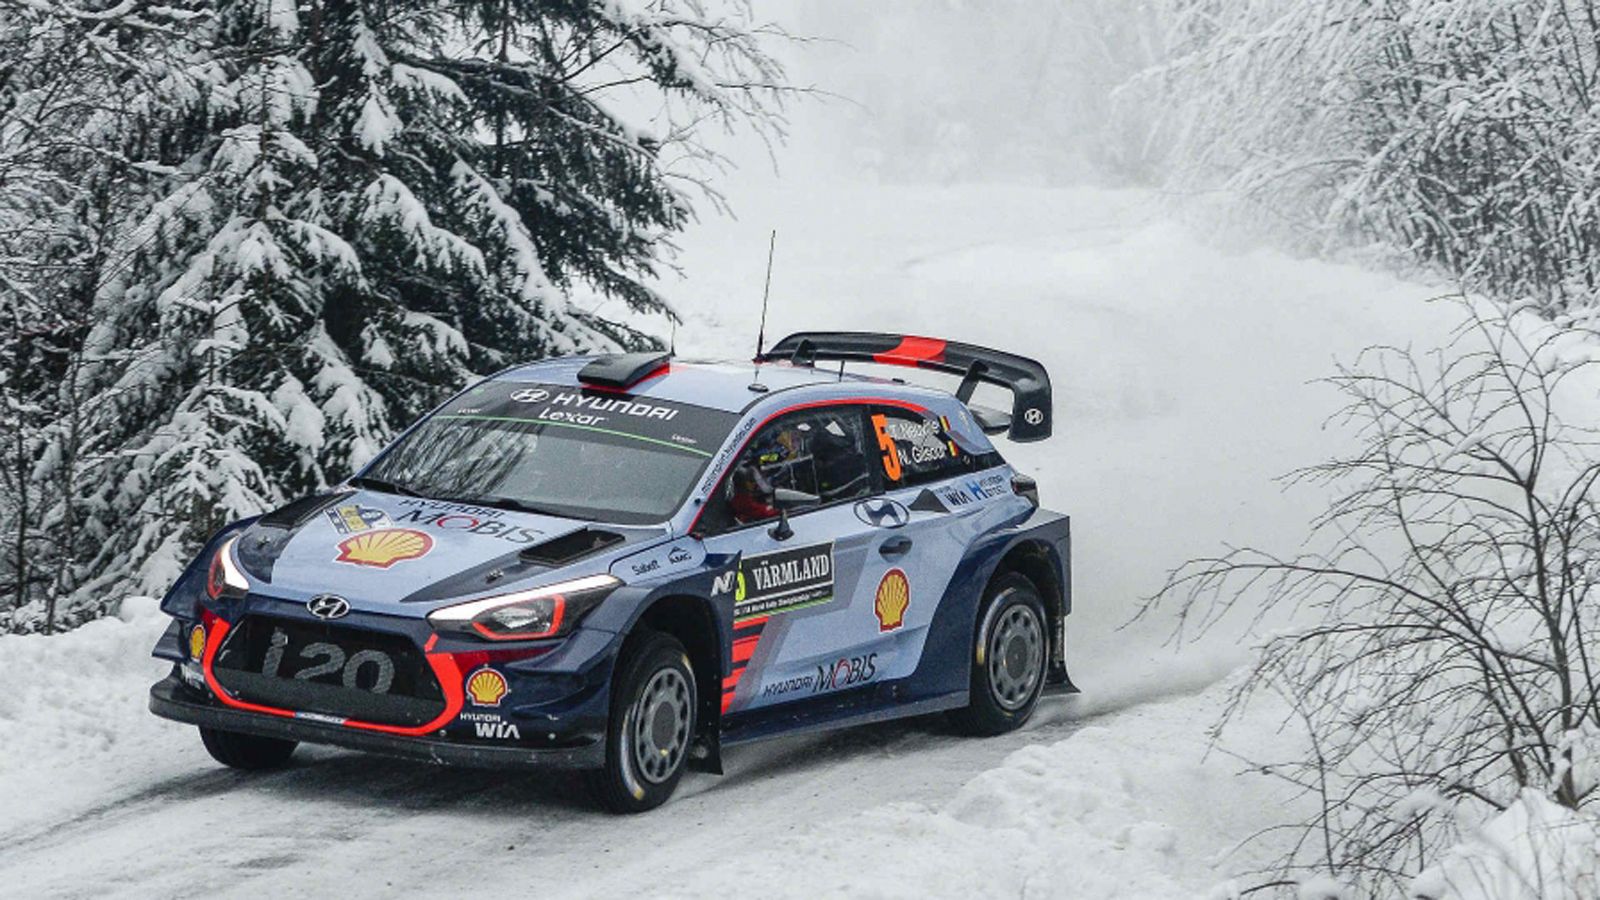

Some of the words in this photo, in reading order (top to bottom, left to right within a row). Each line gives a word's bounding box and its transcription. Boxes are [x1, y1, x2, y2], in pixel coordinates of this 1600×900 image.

[538, 407, 606, 427] Lexar
[552, 391, 679, 421] HYUNDAI
[871, 413, 902, 481] 5
[397, 509, 545, 544] MOBIS
[398, 499, 508, 519] HYUNDAI
[752, 553, 830, 591] VÄRMLAND
[763, 675, 814, 697] HYUNDAI
[812, 653, 878, 692] MOBIS
